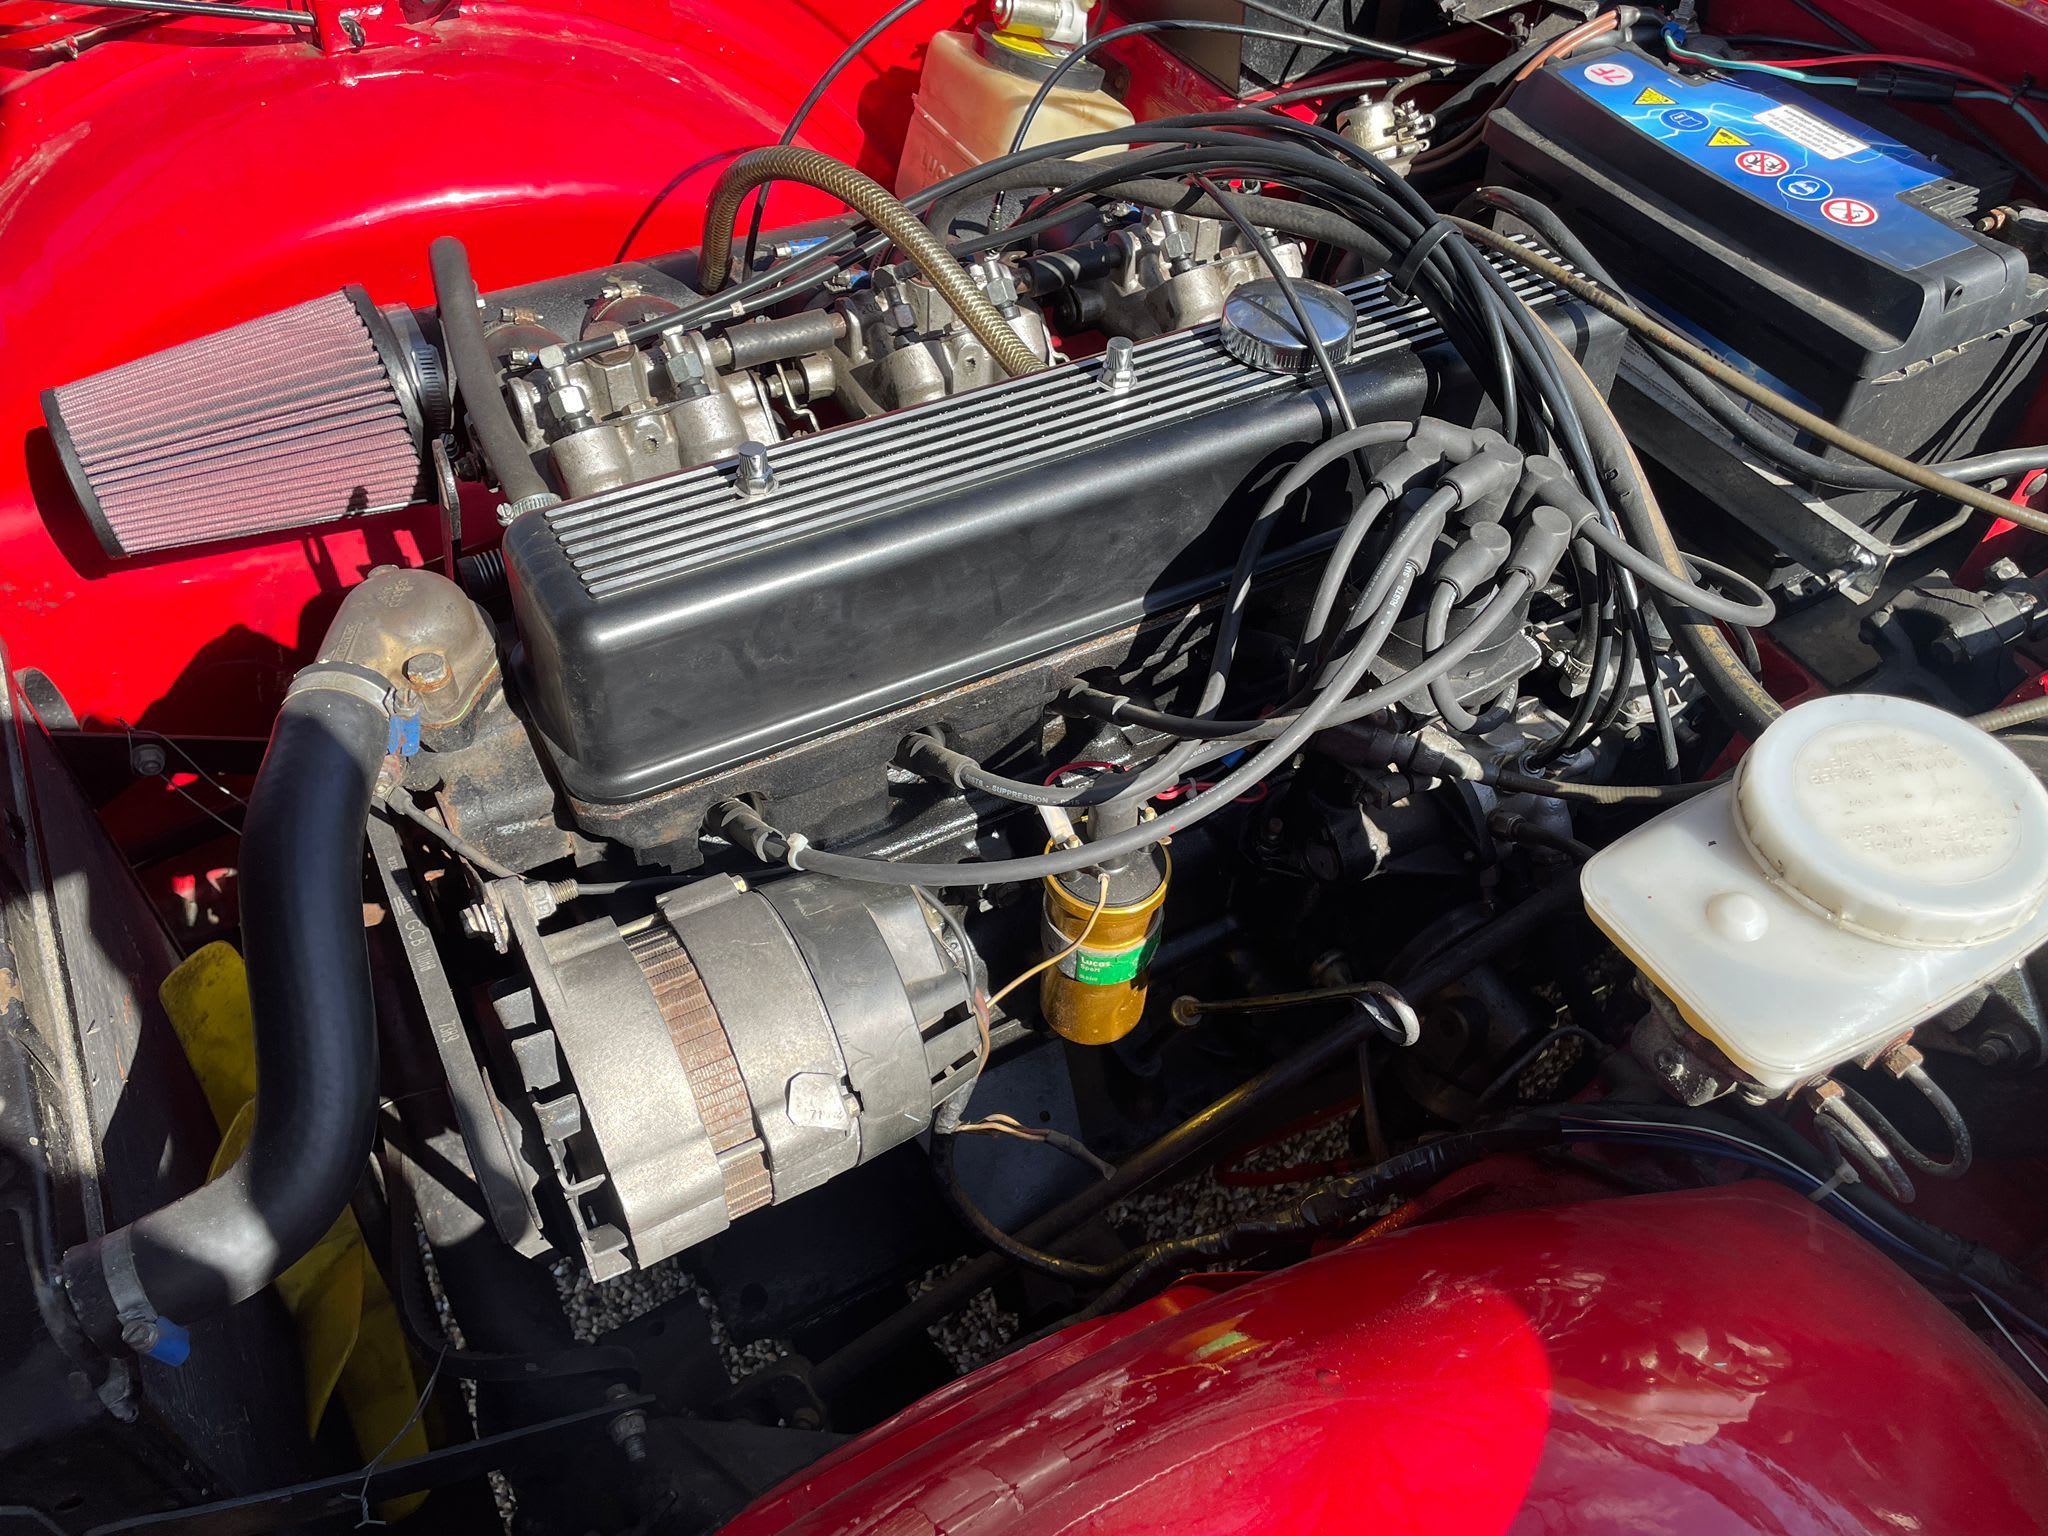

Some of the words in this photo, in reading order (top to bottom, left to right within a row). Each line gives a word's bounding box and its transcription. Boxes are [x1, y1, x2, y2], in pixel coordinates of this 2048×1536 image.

[1590, 67, 1625, 84] 7F
[992, 784, 1050, 804] SUPPRESSION
[405, 919, 428, 947] GCB
[1080, 963, 1100, 972] Sport
[1081, 956, 1111, 967] Lucas
